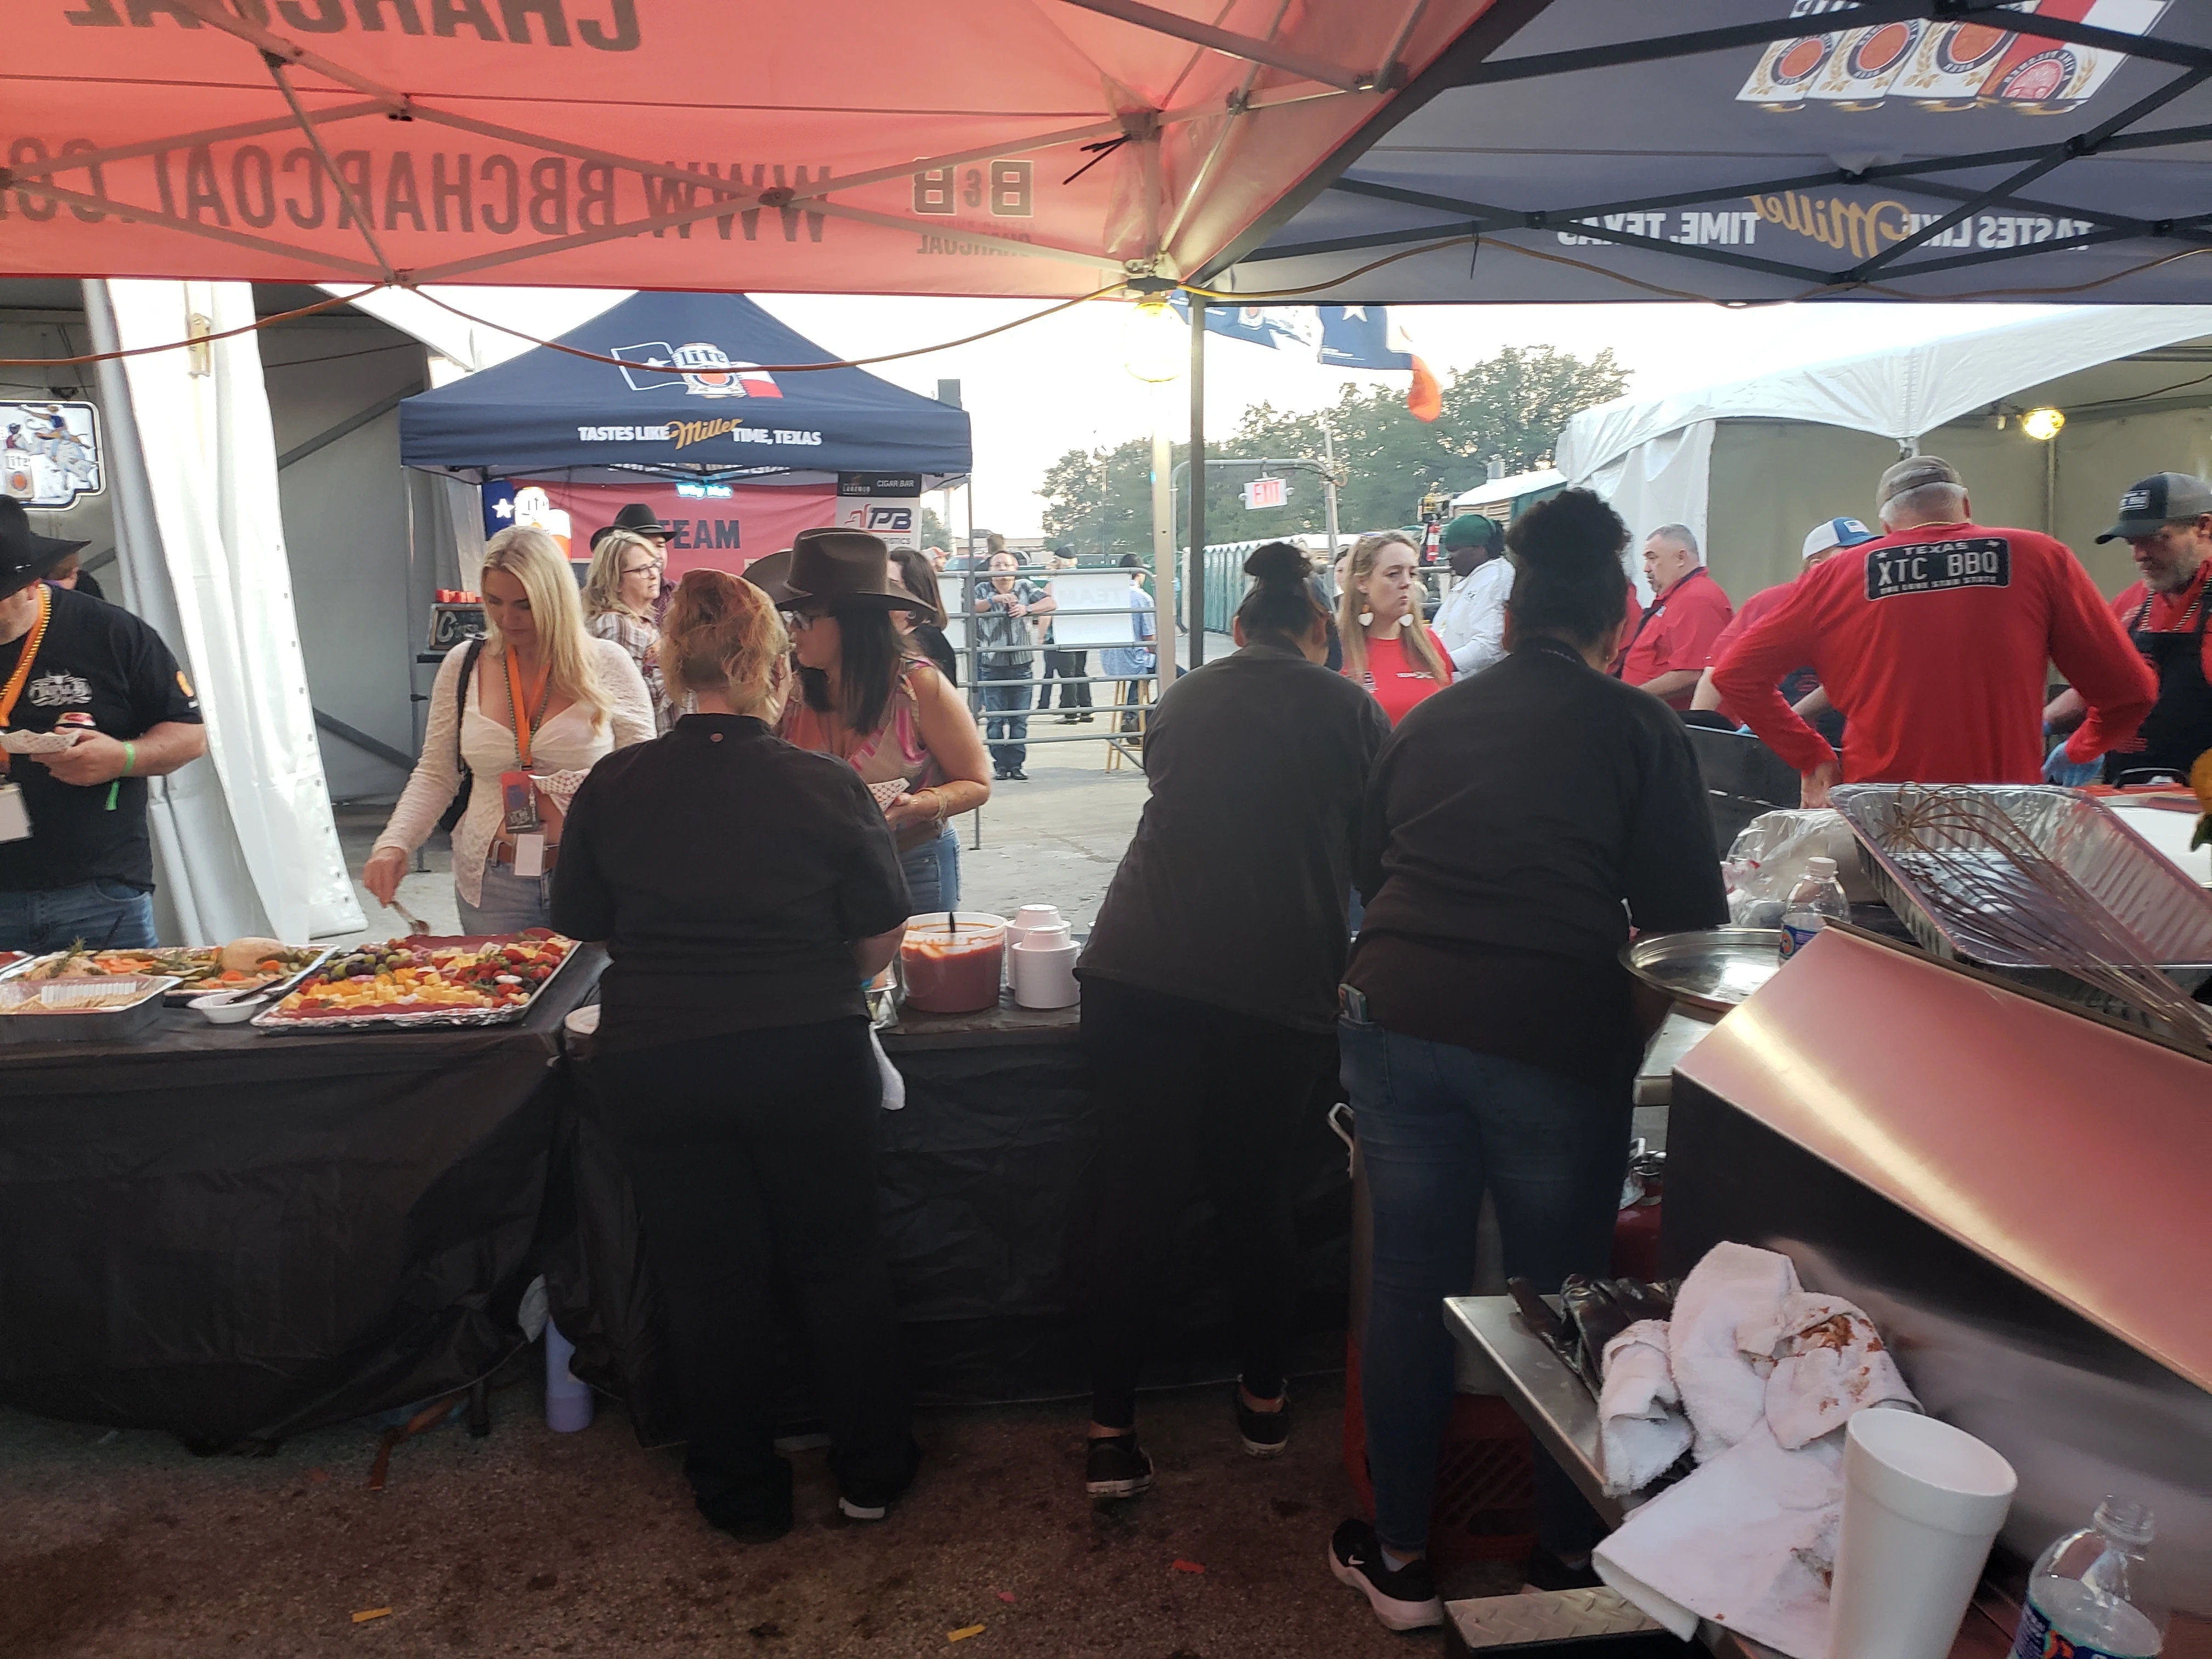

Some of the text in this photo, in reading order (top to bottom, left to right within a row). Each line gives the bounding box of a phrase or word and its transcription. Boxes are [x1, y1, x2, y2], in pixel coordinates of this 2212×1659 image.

[577, 417, 822, 450] TASTES LIKE Miller TIME, TEXAS
[876, 479, 915, 488] CIGAR BAR
[1254, 481, 1281, 506] EXIT
[1903, 542, 1970, 556] TEXAS
[1877, 550, 2000, 587] XTC BBQ
